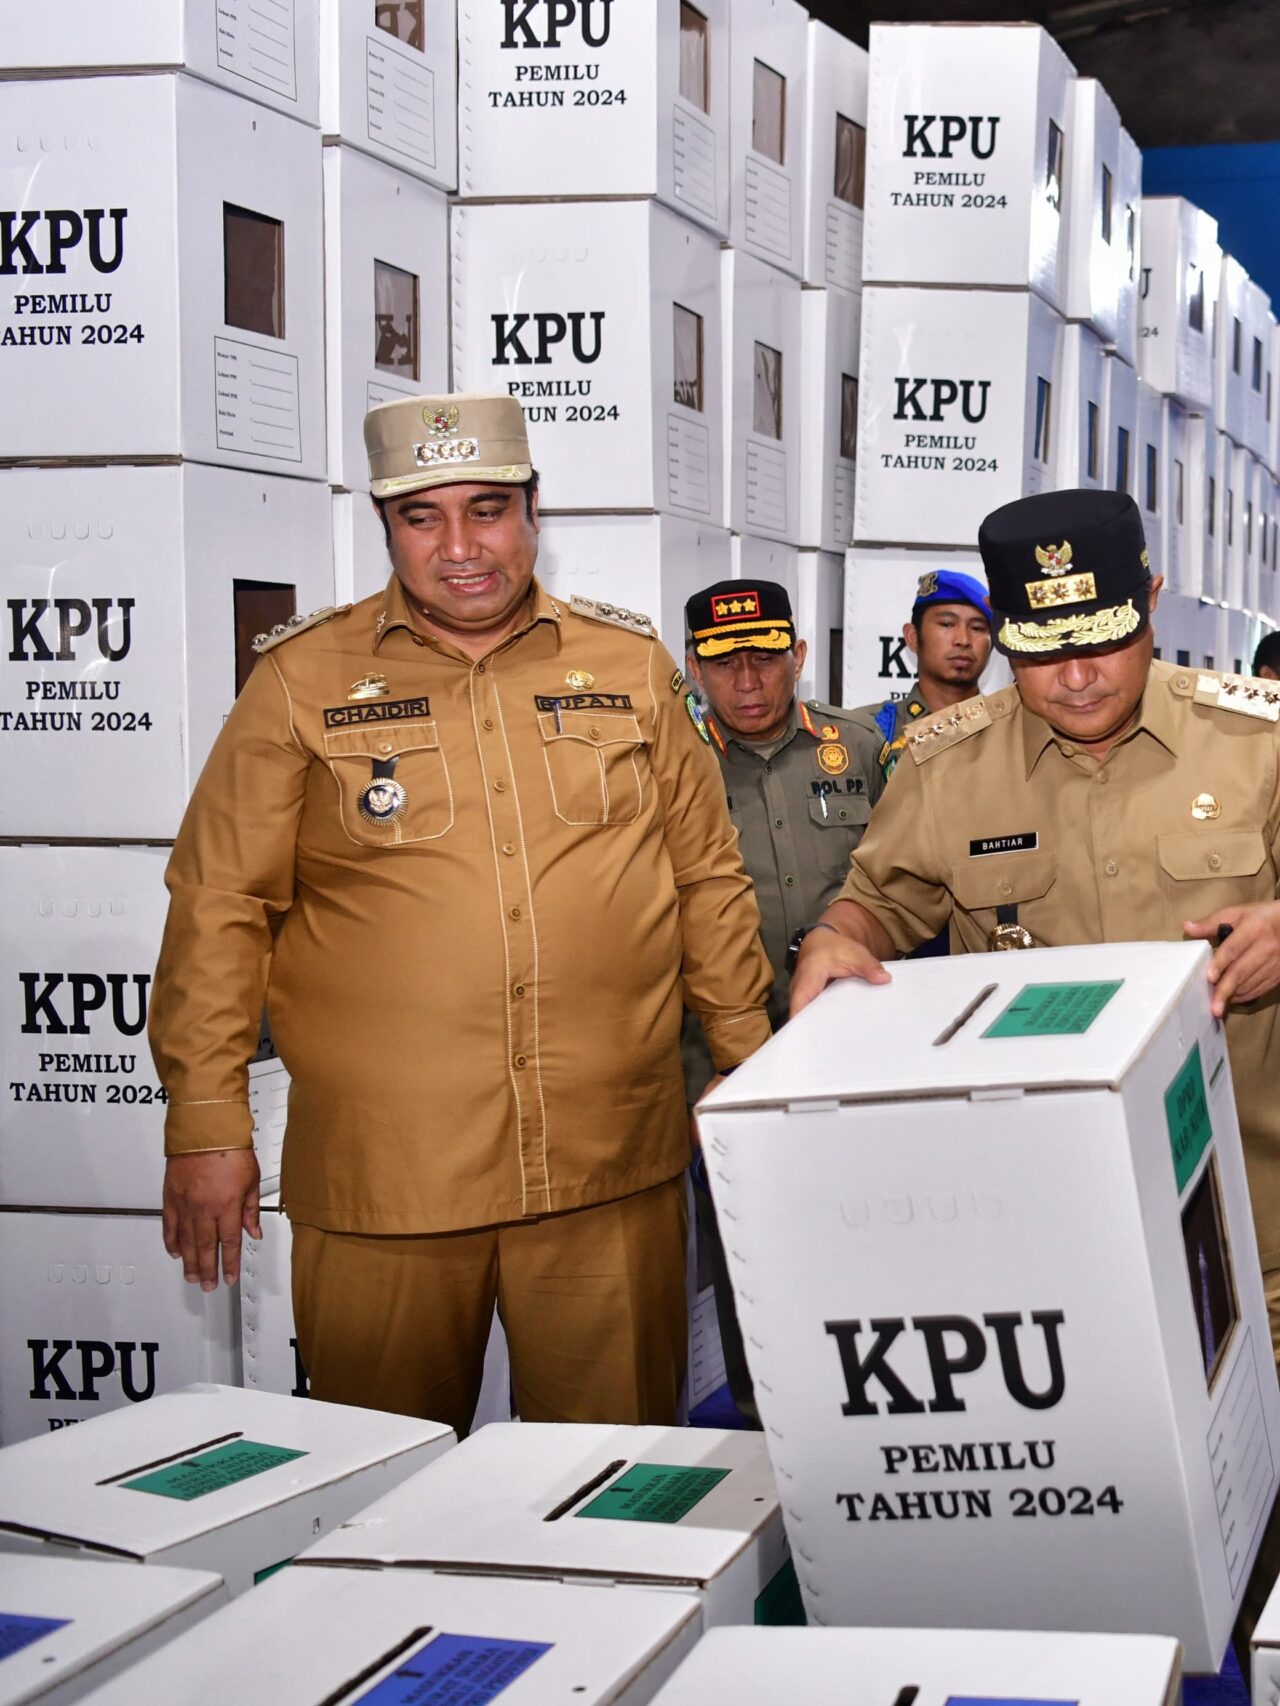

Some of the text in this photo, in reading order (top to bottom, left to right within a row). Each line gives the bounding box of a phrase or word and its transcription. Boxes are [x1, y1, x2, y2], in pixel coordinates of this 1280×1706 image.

[501, 0, 614, 48] KPU
[515, 64, 600, 81] PEMILU
[488, 89, 627, 108] TAHUN 2024
[903, 115, 1000, 160] KPU
[914, 171, 985, 187] PEMILU
[891, 193, 1008, 209] TAHUN 2024
[0, 208, 128, 275] KPU
[14, 293, 112, 315] PEMILU
[1, 324, 145, 346] AHUN 2024
[491, 311, 605, 365] KPU
[507, 380, 592, 397] PEMILU
[893, 377, 991, 424] KPU
[565, 405, 620, 422] 2024
[905, 434, 976, 450] PEMILU
[881, 454, 999, 472] TAHUN 2024
[7, 597, 135, 662] KPU
[25, 681, 121, 700] PEMILU
[0, 711, 153, 731] TAHUN 2024
[329, 702, 426, 724] CHAIDIR
[811, 779, 863, 796] POL PP
[982, 837, 1023, 850] BAHTIAR
[19, 973, 151, 1036] KPU
[39, 1053, 137, 1074] PEMILU
[10, 1082, 168, 1104] TAHUN 2024
[27, 1339, 159, 1402] KPU
[825, 1310, 1066, 1417] KPU
[880, 1440, 1056, 1474] PEMILU
[835, 1486, 1125, 1522] TAHUN 2024
